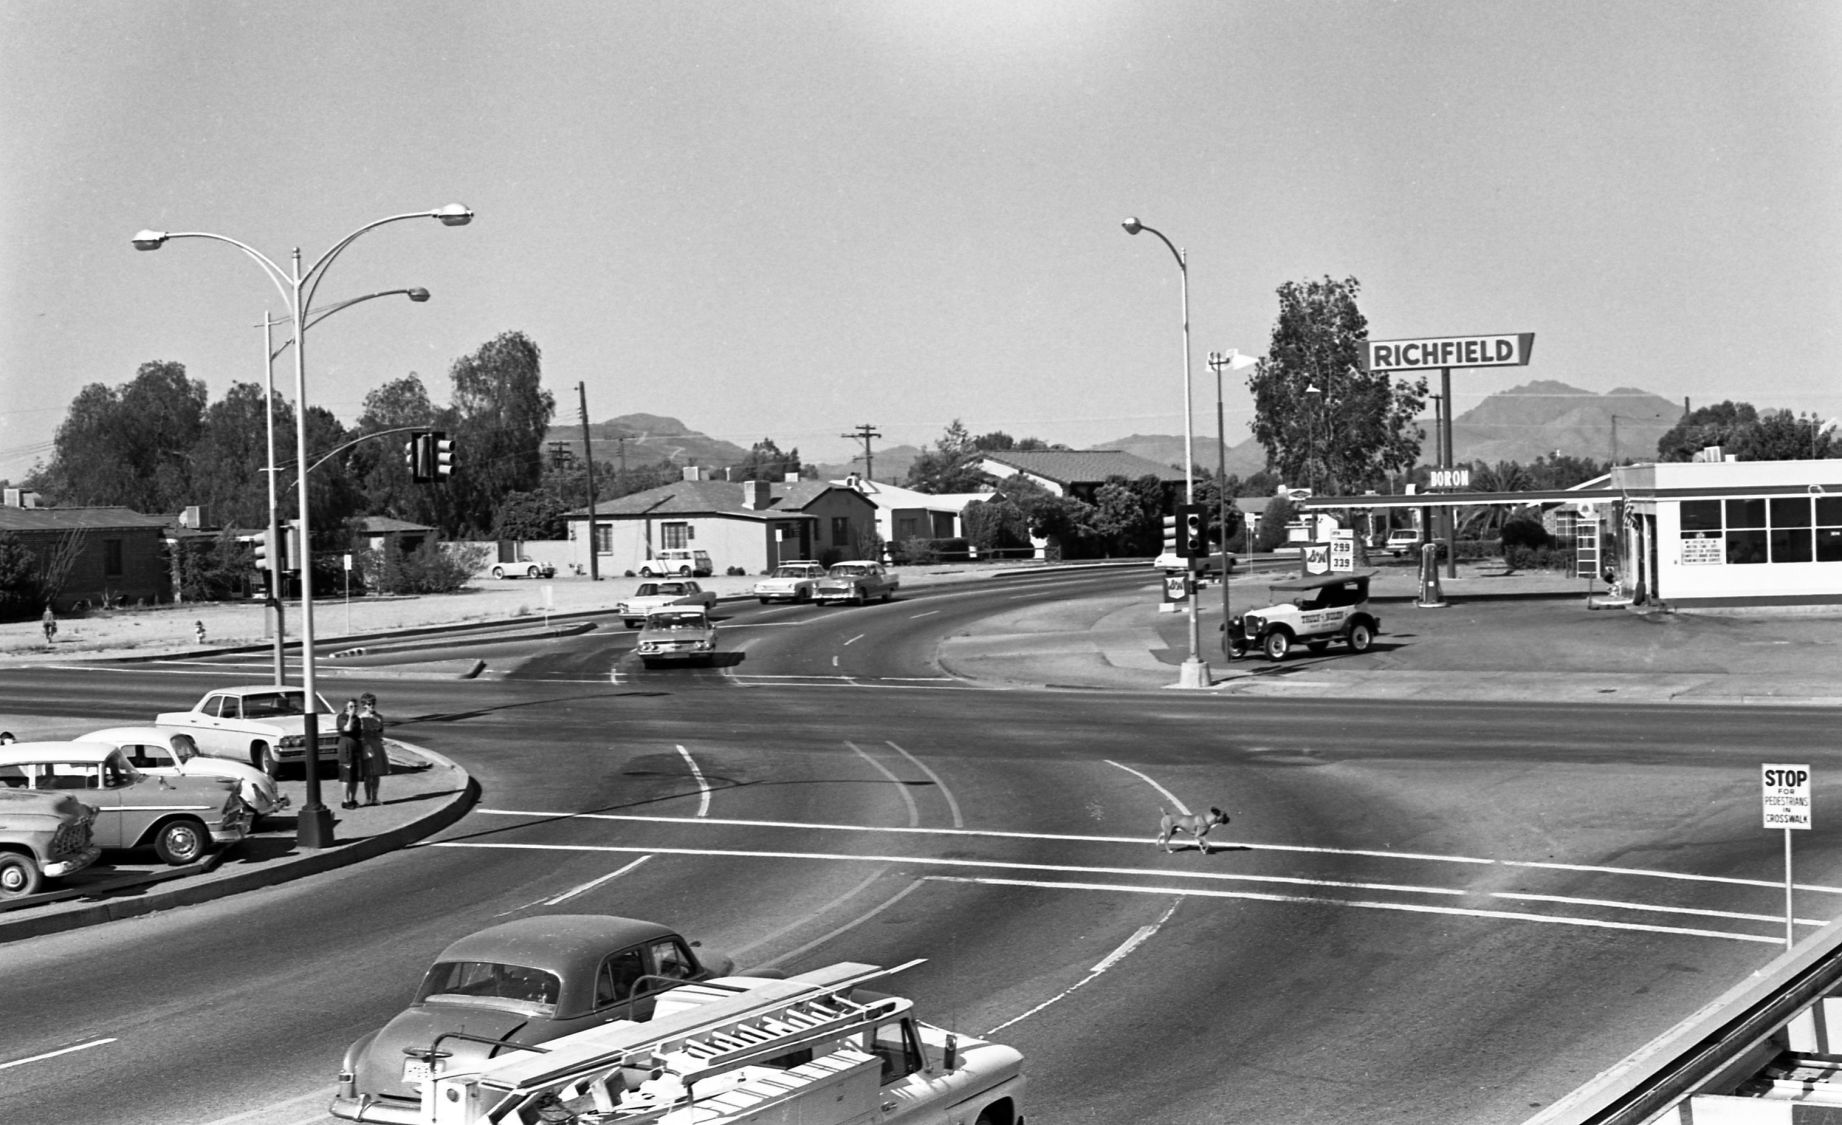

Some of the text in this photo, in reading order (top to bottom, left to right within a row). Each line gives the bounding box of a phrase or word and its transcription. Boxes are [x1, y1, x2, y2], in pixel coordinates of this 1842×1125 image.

[1374, 339, 1514, 367] RICHFIELD
[1430, 470, 1469, 487] BORON
[1333, 543, 1350, 552] 299
[1333, 558, 1350, 567] 339
[1765, 769, 1807, 787] STOP
[1764, 796, 1809, 807] PEDESTRIANS
[1766, 814, 1809, 824] CROSSWALK
